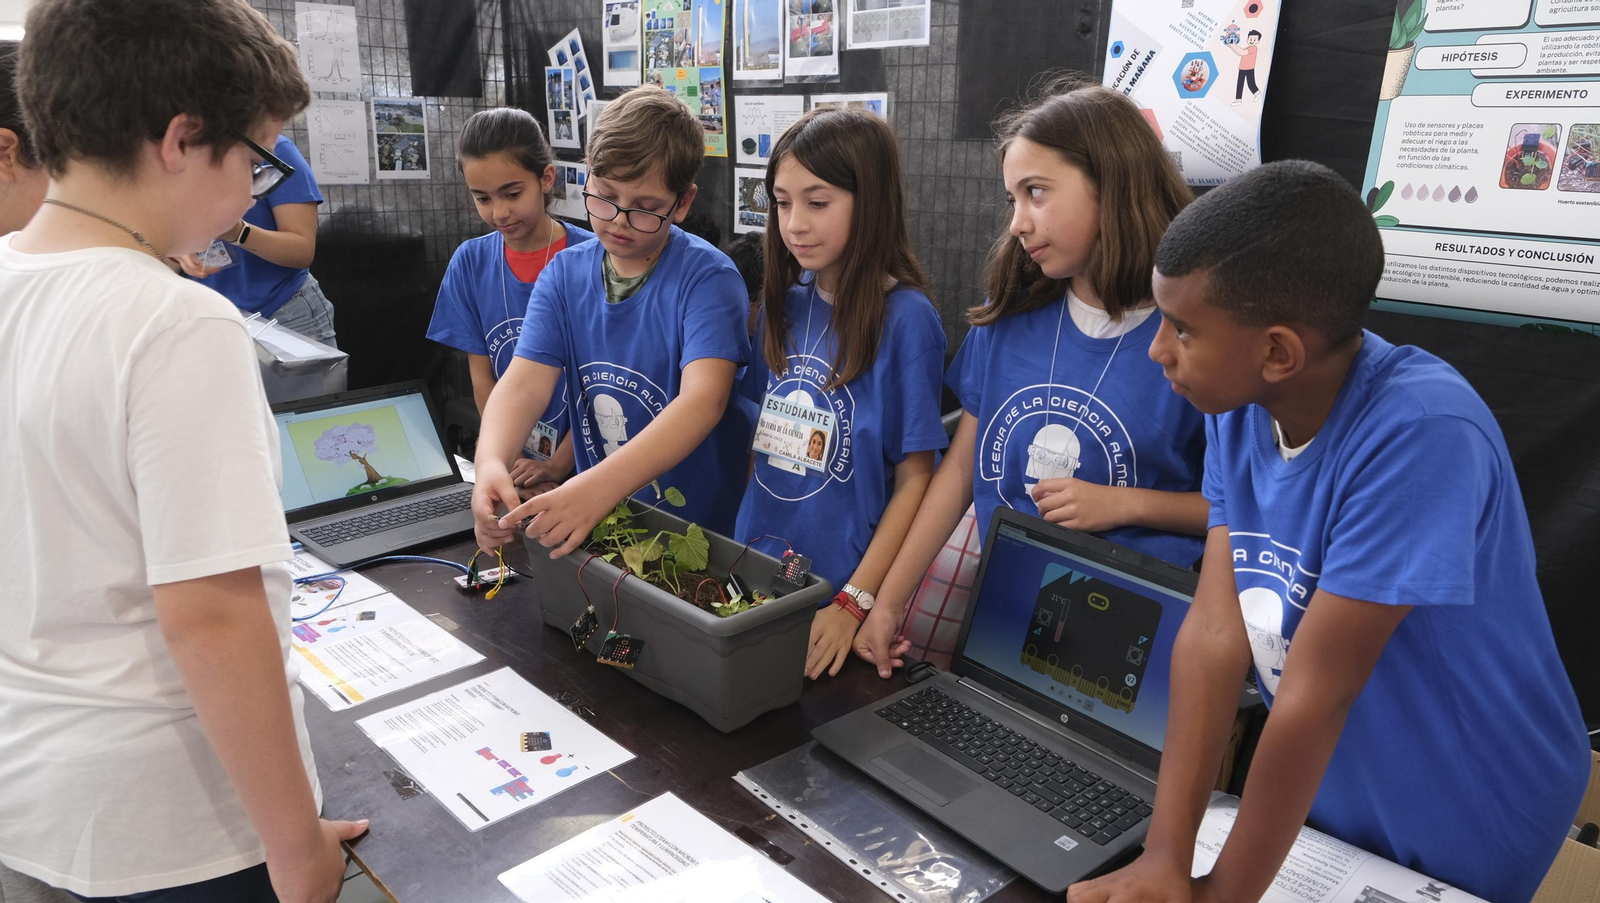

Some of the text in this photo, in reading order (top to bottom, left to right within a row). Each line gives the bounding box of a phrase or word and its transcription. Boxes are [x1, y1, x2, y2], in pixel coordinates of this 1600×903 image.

[1436, 4, 1465, 12] plantas?
[1549, 6, 1589, 14] agricultura
[1130, 48, 1140, 60] DE
[1441, 51, 1498, 62] HIPÓTESIS
[1129, 50, 1156, 87] MAÑANA
[1506, 89, 1588, 99] EXPERIMENTO
[1435, 242, 1594, 264] RESULTADOS Y CONCLUSIÓN
[1392, 269, 1421, 277] ecológico
[1463, 276, 1500, 285] reduciendo
[1509, 281, 1540, 289] cantidad
[1429, 265, 1456, 273] distintos
[1458, 268, 1497, 277] dispositivos
[1546, 277, 1578, 285] podemos
[490, 329, 513, 351] DE LA
[583, 375, 590, 385] A
[592, 372, 637, 390] CIENCIA
[766, 399, 830, 426] ESTUDIANTE
[834, 399, 851, 472] ALMERÍA
[992, 396, 1128, 487] FERIA DE LA CIENCIA ALME
[779, 450, 822, 467] CAMILA ALBACETE
[1233, 548, 1247, 561] A
[1197, 840, 1219, 854] CROB
[1288, 859, 1339, 885] Materiales: placa
[1328, 864, 1347, 875] Cómo
[1276, 872, 1326, 898] PLACA EXPA
[1286, 869, 1332, 892] HUMEDAD
